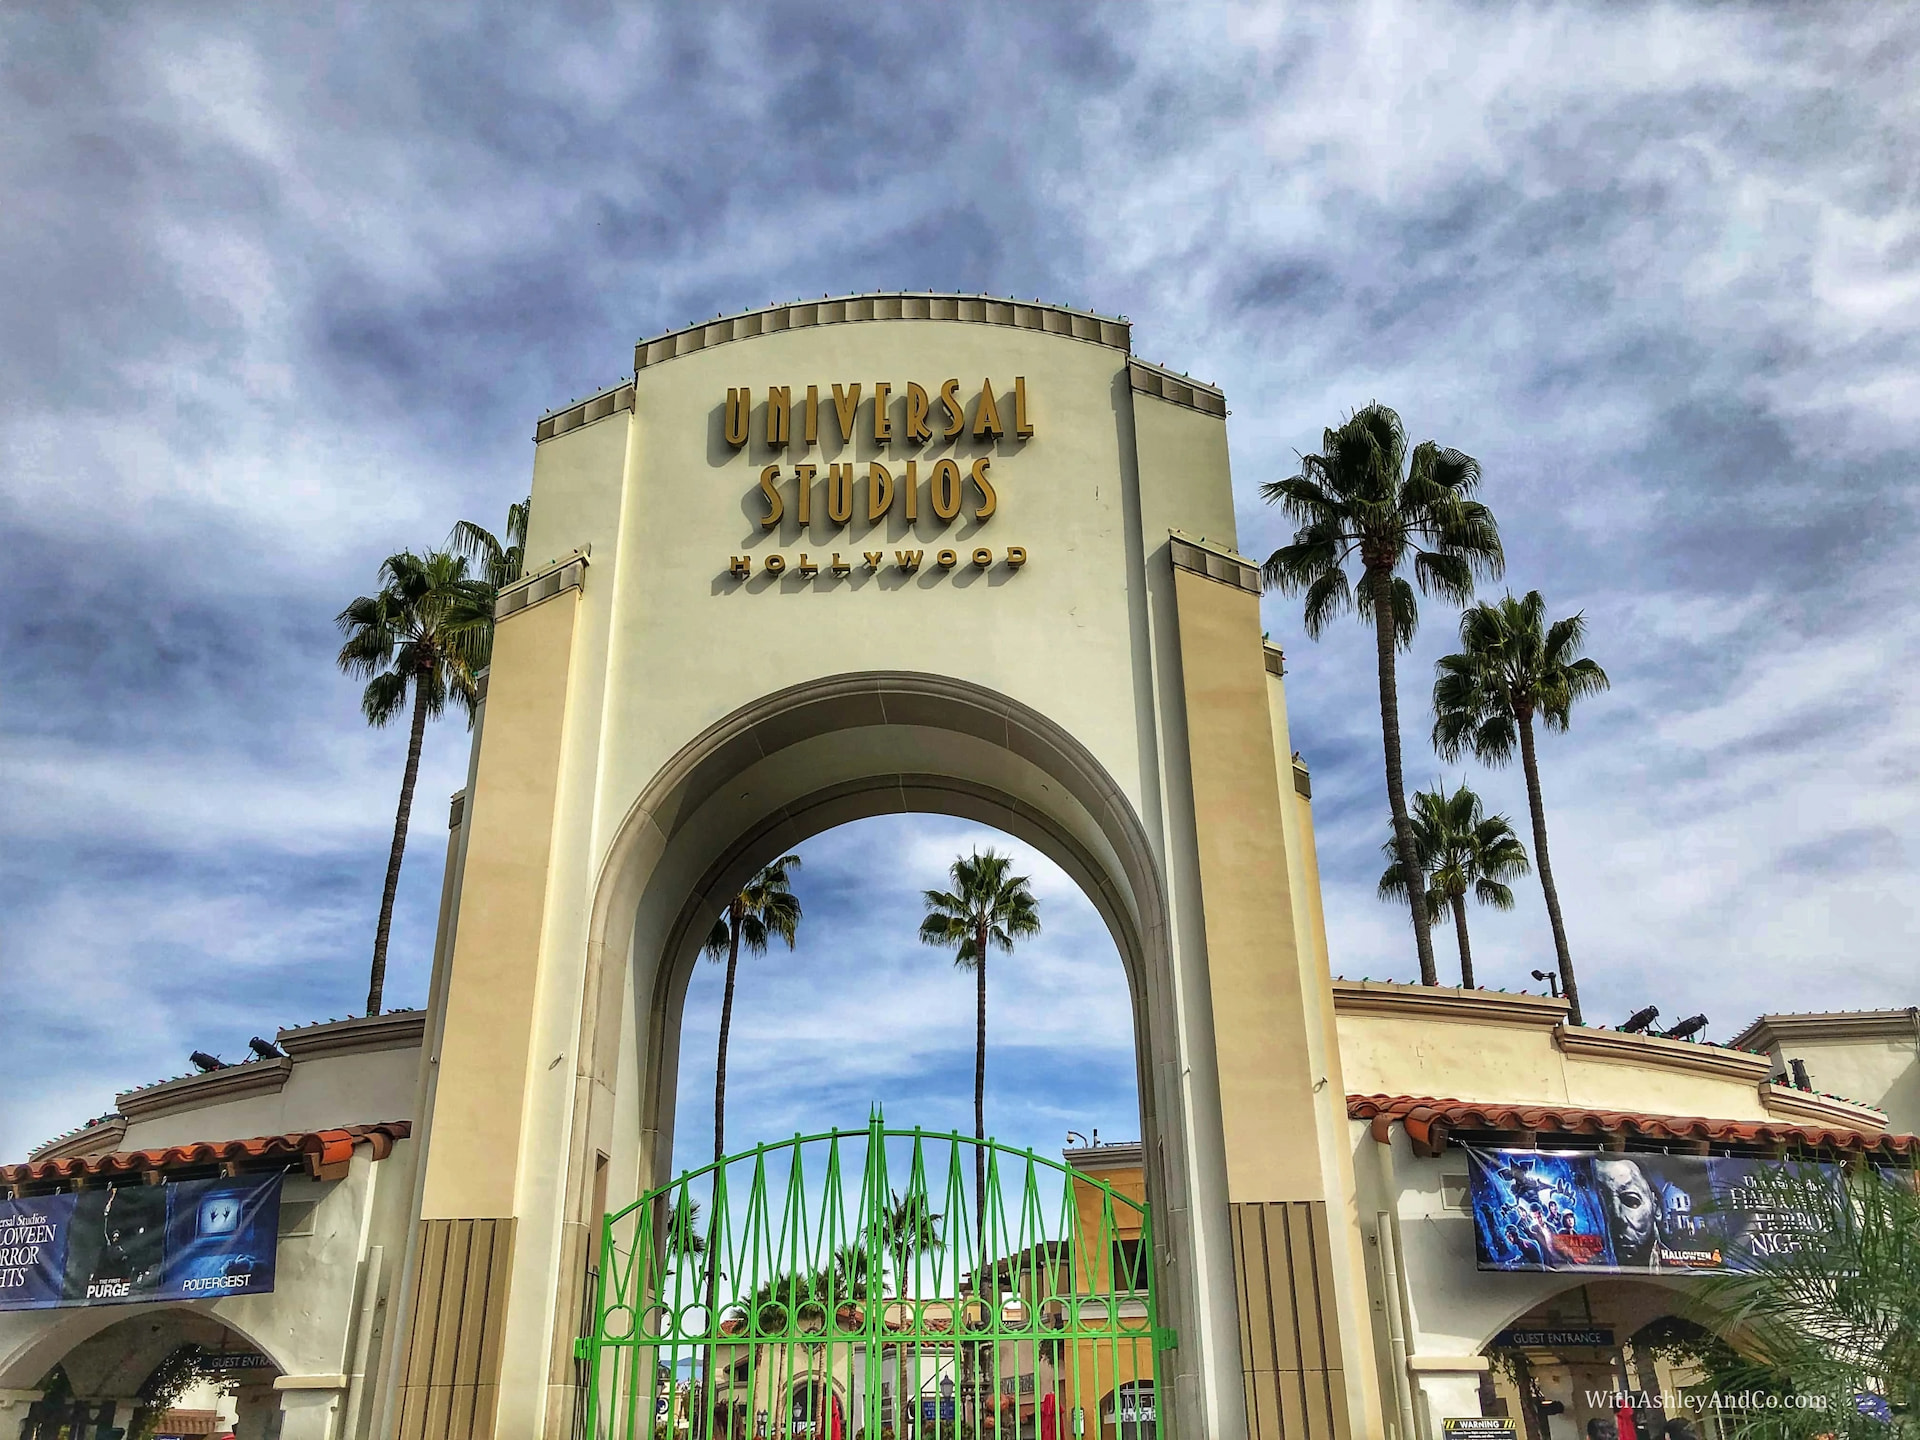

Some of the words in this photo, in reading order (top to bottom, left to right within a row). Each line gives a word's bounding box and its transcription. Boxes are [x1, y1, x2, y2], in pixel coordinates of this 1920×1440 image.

[725, 376, 1034, 447] UNIVERSAL
[760, 457, 997, 529] STUDIOS
[730, 546, 1027, 578] HOLLYWOOD
[16, 1213, 48, 1226] Studios
[0, 1245, 39, 1267] RROR
[1661, 1249, 1712, 1260] HALLOWEEN
[182, 1274, 251, 1291] POLTERGEIST
[86, 1283, 131, 1299] PURGE
[1513, 1333, 1544, 1344] GUEST
[1547, 1332, 1601, 1343] ENTRANCE
[211, 1356, 240, 1368] GUEST
[1459, 1420, 1499, 1428] WARNING
